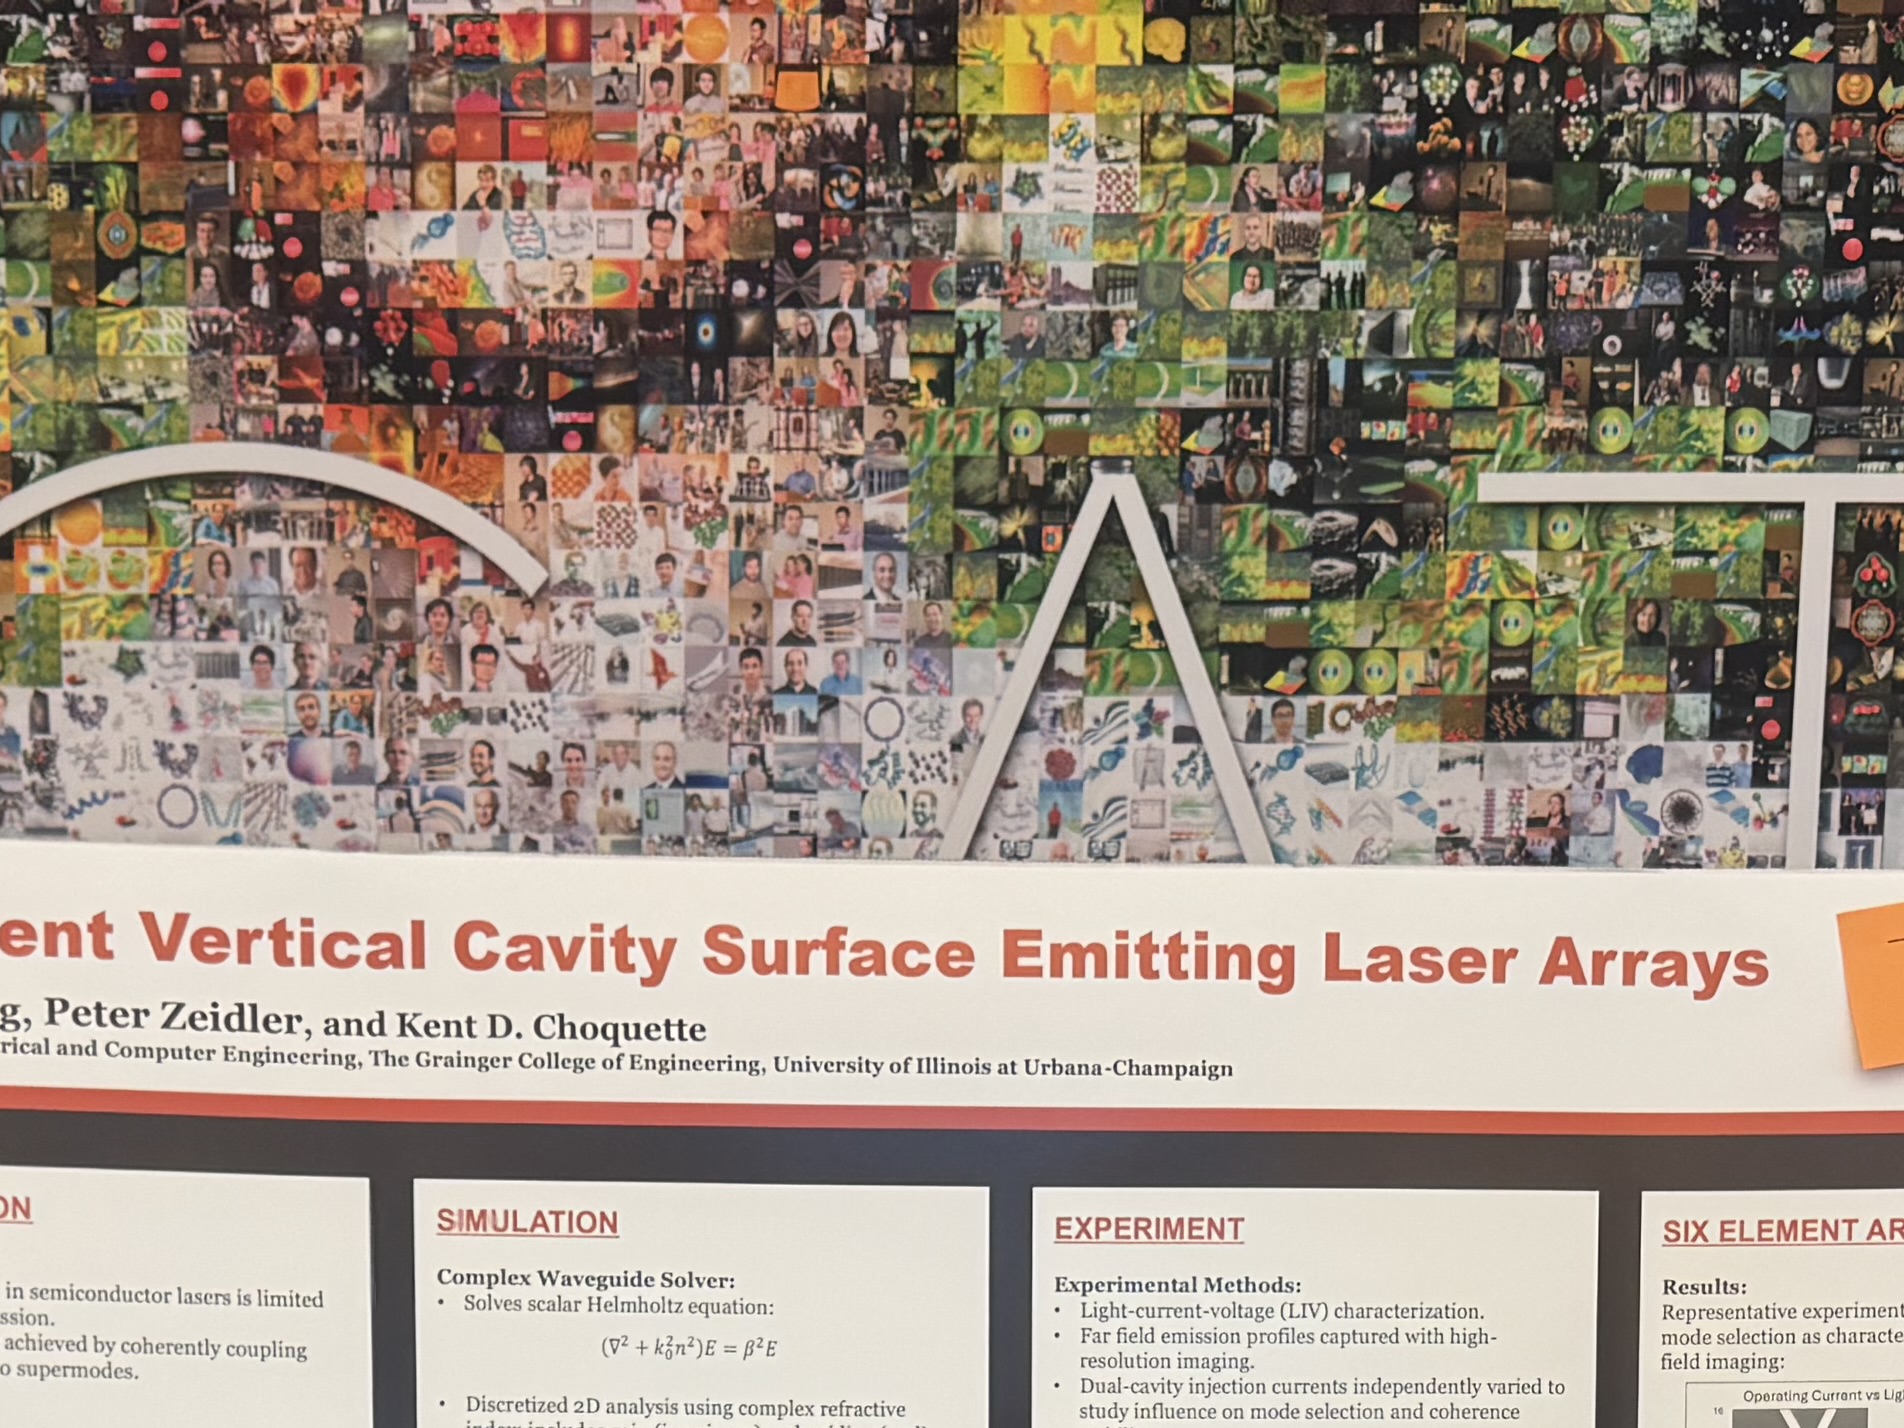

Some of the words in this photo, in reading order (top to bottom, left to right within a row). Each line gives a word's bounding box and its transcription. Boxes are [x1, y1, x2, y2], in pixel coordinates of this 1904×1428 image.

[138, 909, 426, 971] Vertical
[453, 918, 678, 988] Cavity
[702, 923, 976, 979] Surface
[1002, 927, 1296, 997] Emitting
[1324, 930, 1520, 986] Laser
[1538, 935, 1770, 1002] Arrays
[44, 996, 151, 1030] Peter
[160, 1000, 313, 1042] Zeidler,
[323, 1008, 388, 1038] and
[395, 1011, 478, 1040] Kent
[487, 1012, 523, 1041] D.
[533, 1012, 707, 1049] Choquette
[56, 1038, 98, 1058] and
[104, 1039, 217, 1064] Computer
[222, 1044, 363, 1070] Engineering,
[367, 1048, 410, 1068] The
[415, 1049, 513, 1071] Grainger
[517, 1050, 596, 1073] College
[601, 1051, 626, 1072] of
[629, 1052, 767, 1077] Engineering,
[773, 1054, 885, 1079] University
[888, 1055, 914, 1076] of
[916, 1055, 992, 1076] Illinois
[996, 1059, 1018, 1077] at
[1023, 1056, 1234, 1082] Urbana-Champaign
[437, 1207, 618, 1236] SIMULATION
[1055, 1215, 1246, 1241] EXPERIMENT
[1663, 1218, 1710, 1244] SIX
[1719, 1217, 1860, 1244] ELEMENT
[436, 1267, 532, 1291] Complex
[536, 1268, 656, 1293] Waveguide
[660, 1269, 735, 1290] Solver:
[1054, 1275, 1198, 1299] Experimental
[1203, 1275, 1302, 1295] Methods:
[1662, 1276, 1747, 1296] Results:
[5, 1280, 25, 1301] in
[29, 1281, 173, 1306] semiconductor
[176, 1285, 232, 1307] lasers
[236, 1286, 253, 1308] is
[256, 1287, 325, 1309] limited
[463, 1292, 523, 1313] Solves
[527, 1293, 583, 1314] scalar
[587, 1294, 684, 1315] Helmholtz
[687, 1296, 774, 1320] equation:
[1080, 1299, 1275, 1324] Light-current-voltage
[1279, 1300, 1329, 1323] (LIV)
[1333, 1299, 1485, 1320] characterization.
[1743, 1388, 1809, 1406] Operating
[1811, 1388, 1863, 1403] Current
[1865, 1390, 1881, 1402] vs
